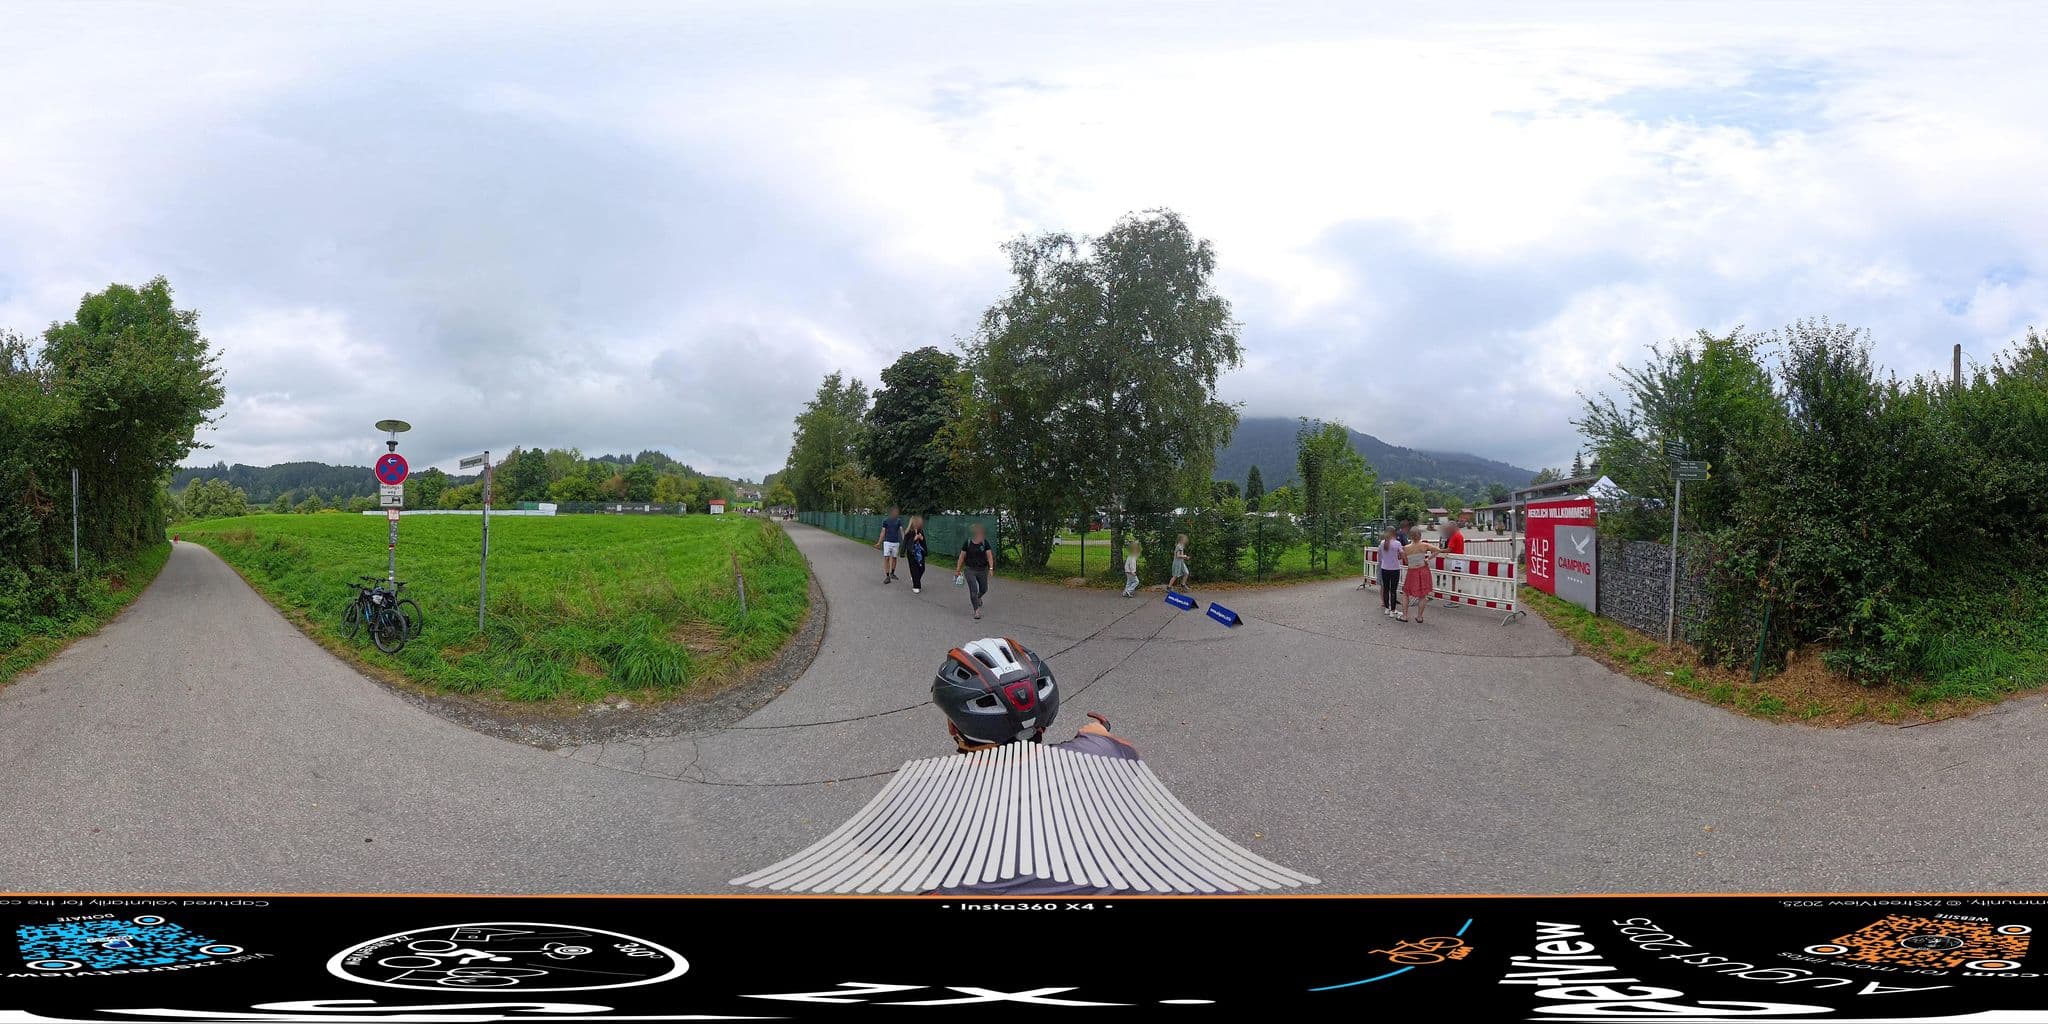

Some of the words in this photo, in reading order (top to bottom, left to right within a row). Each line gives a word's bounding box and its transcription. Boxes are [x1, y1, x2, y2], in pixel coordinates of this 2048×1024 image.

[1531, 538, 1549, 557] ALP
[1531, 557, 1550, 579] SEE
[1558, 556, 1591, 575] CAMPING
